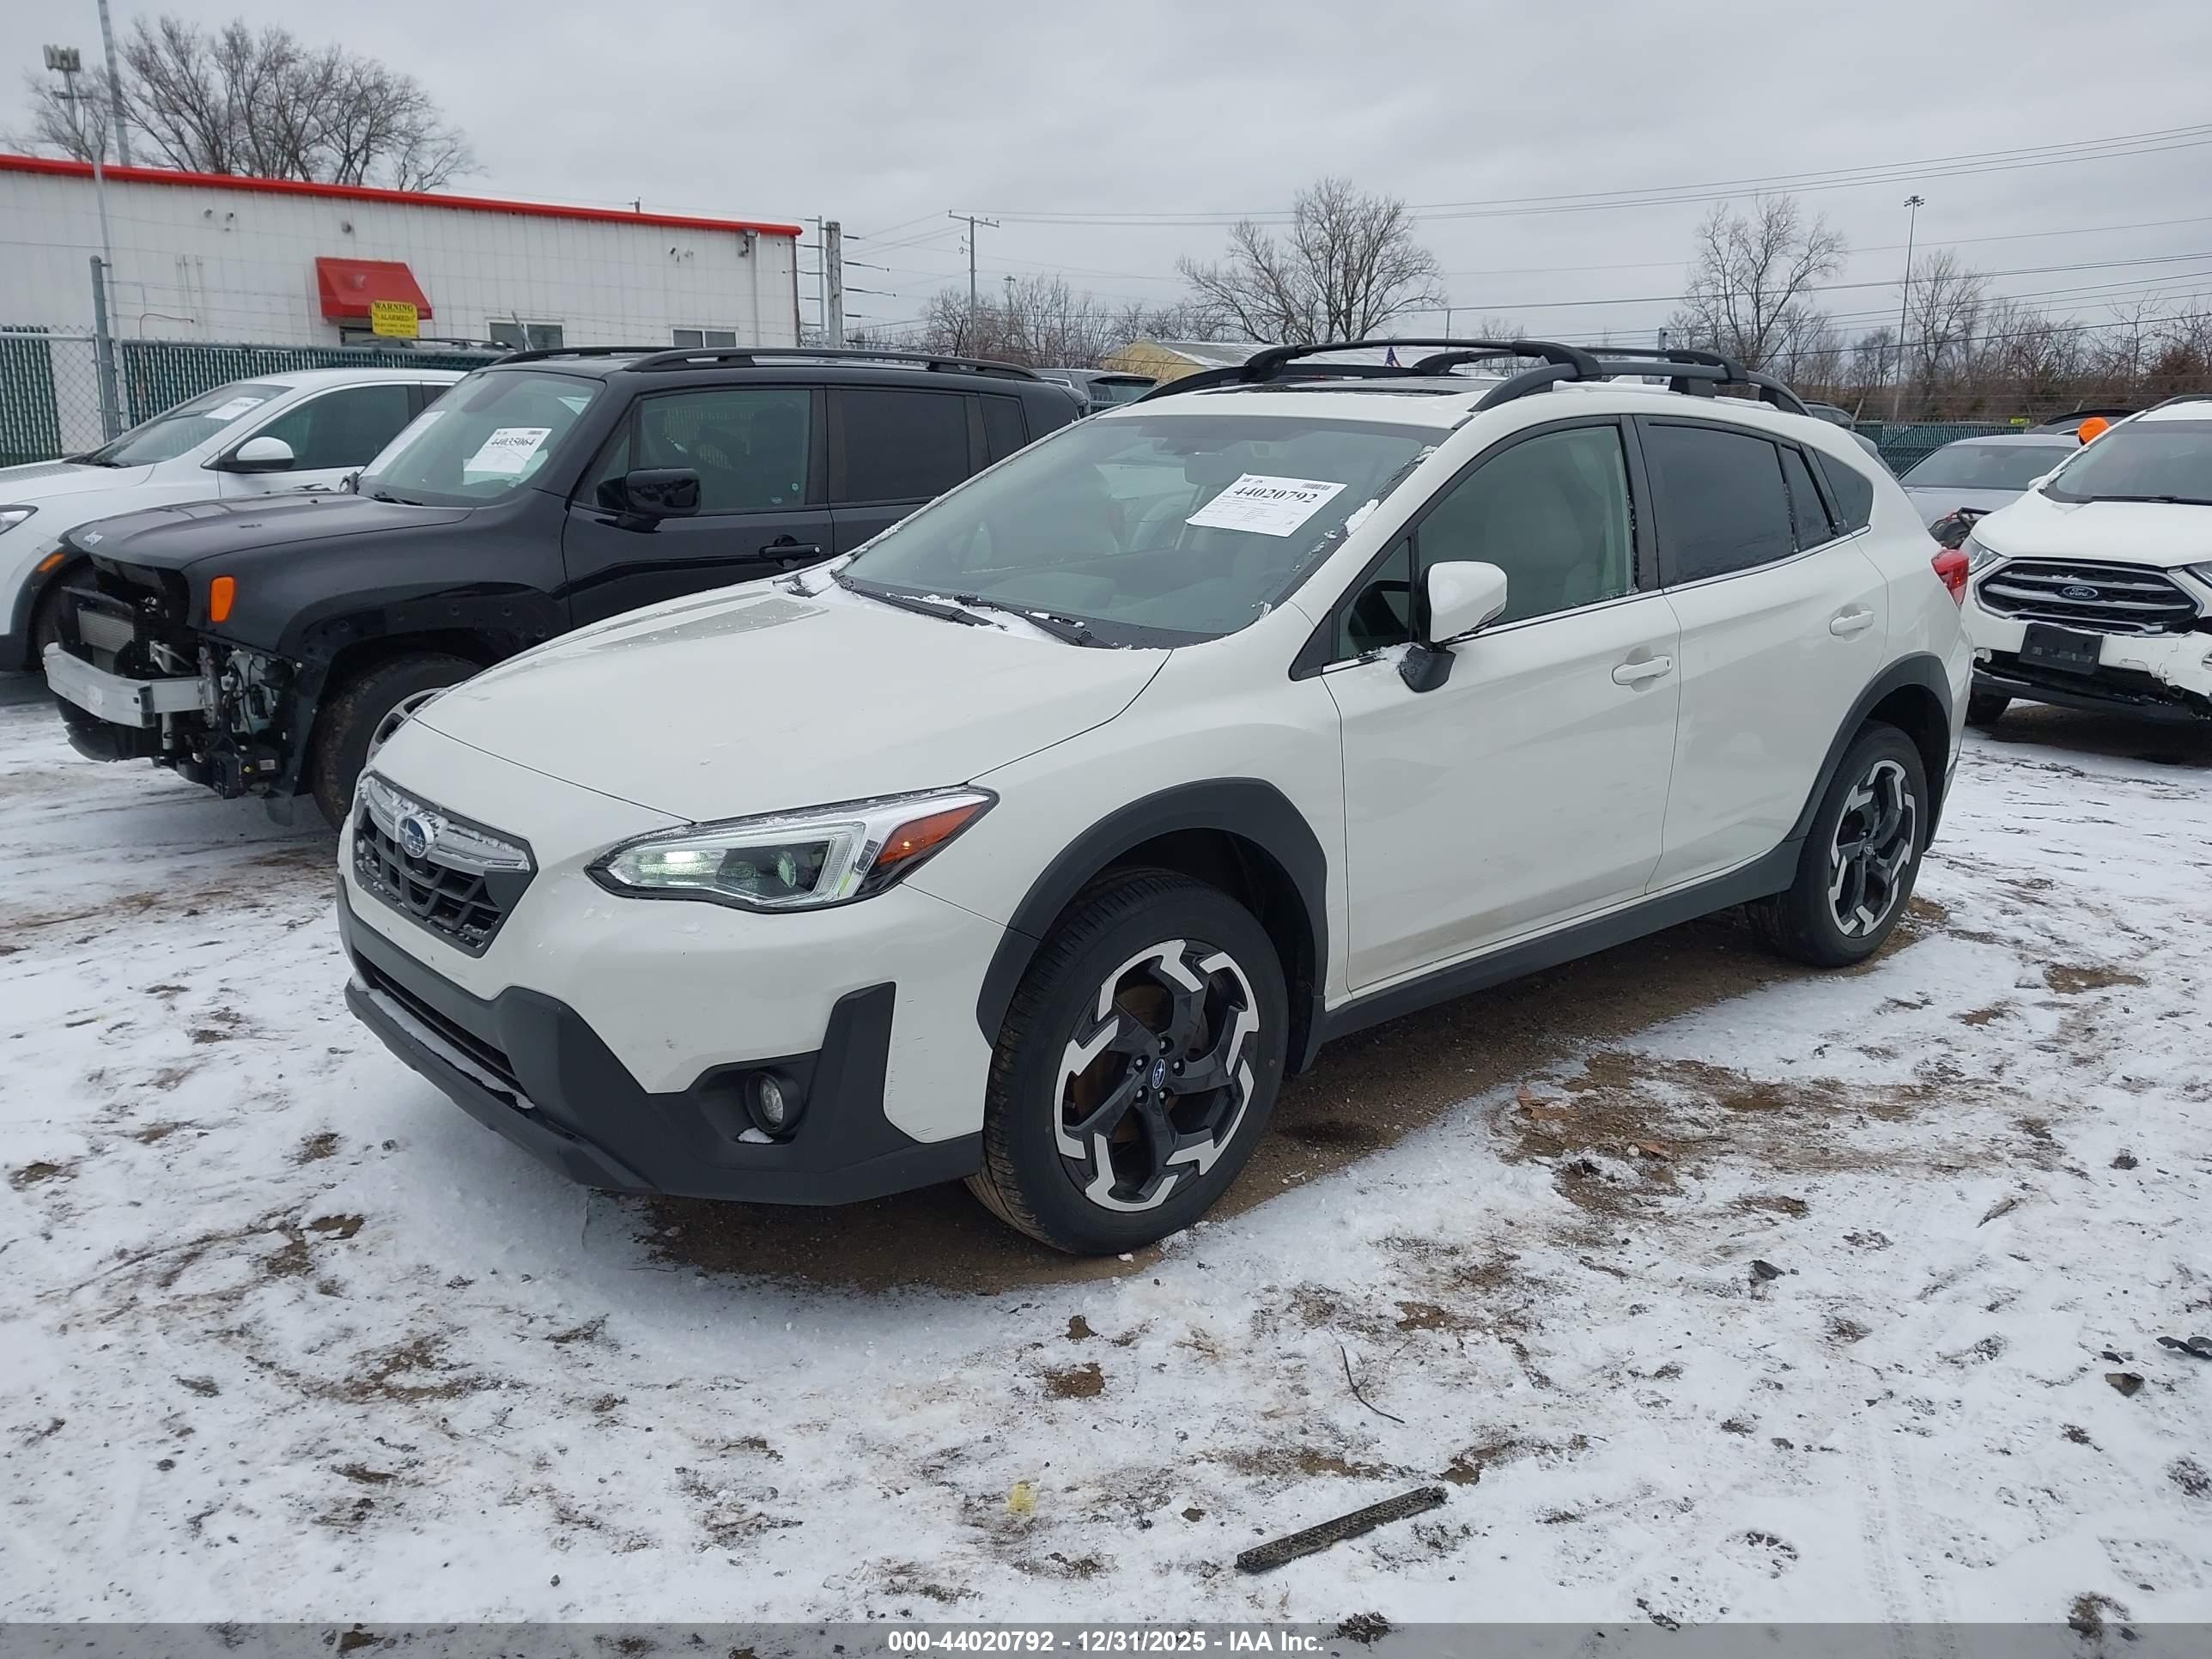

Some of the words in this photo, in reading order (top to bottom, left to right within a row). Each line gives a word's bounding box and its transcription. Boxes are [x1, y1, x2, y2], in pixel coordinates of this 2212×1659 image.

[374, 301, 413, 313] WARNING
[380, 313, 410, 322] ALARMED
[1233, 486, 1318, 503] 44020792
